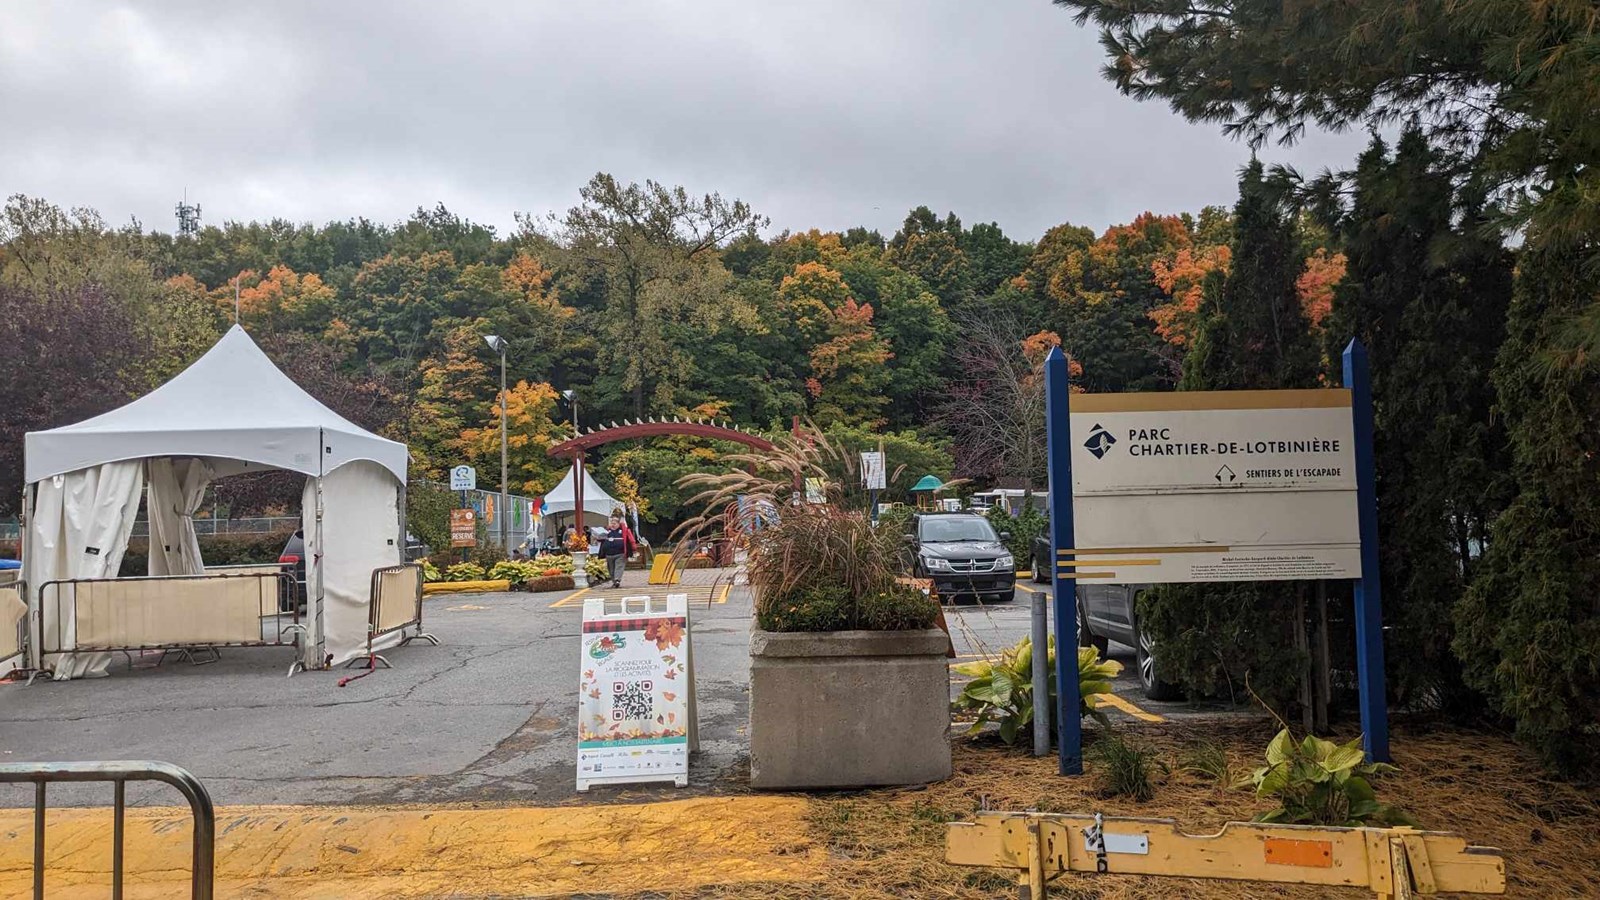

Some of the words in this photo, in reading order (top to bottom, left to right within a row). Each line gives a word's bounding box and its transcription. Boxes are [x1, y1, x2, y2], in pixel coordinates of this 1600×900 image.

[1129, 428, 1170, 441] PARC
[1129, 437, 1340, 456] CHARTIER-DE-LOTBINIÈRE
[1246, 469, 1282, 479] SENTIERS
[1284, 469, 1294, 478] DE
[1296, 468, 1341, 478] L'ESCAPADE
